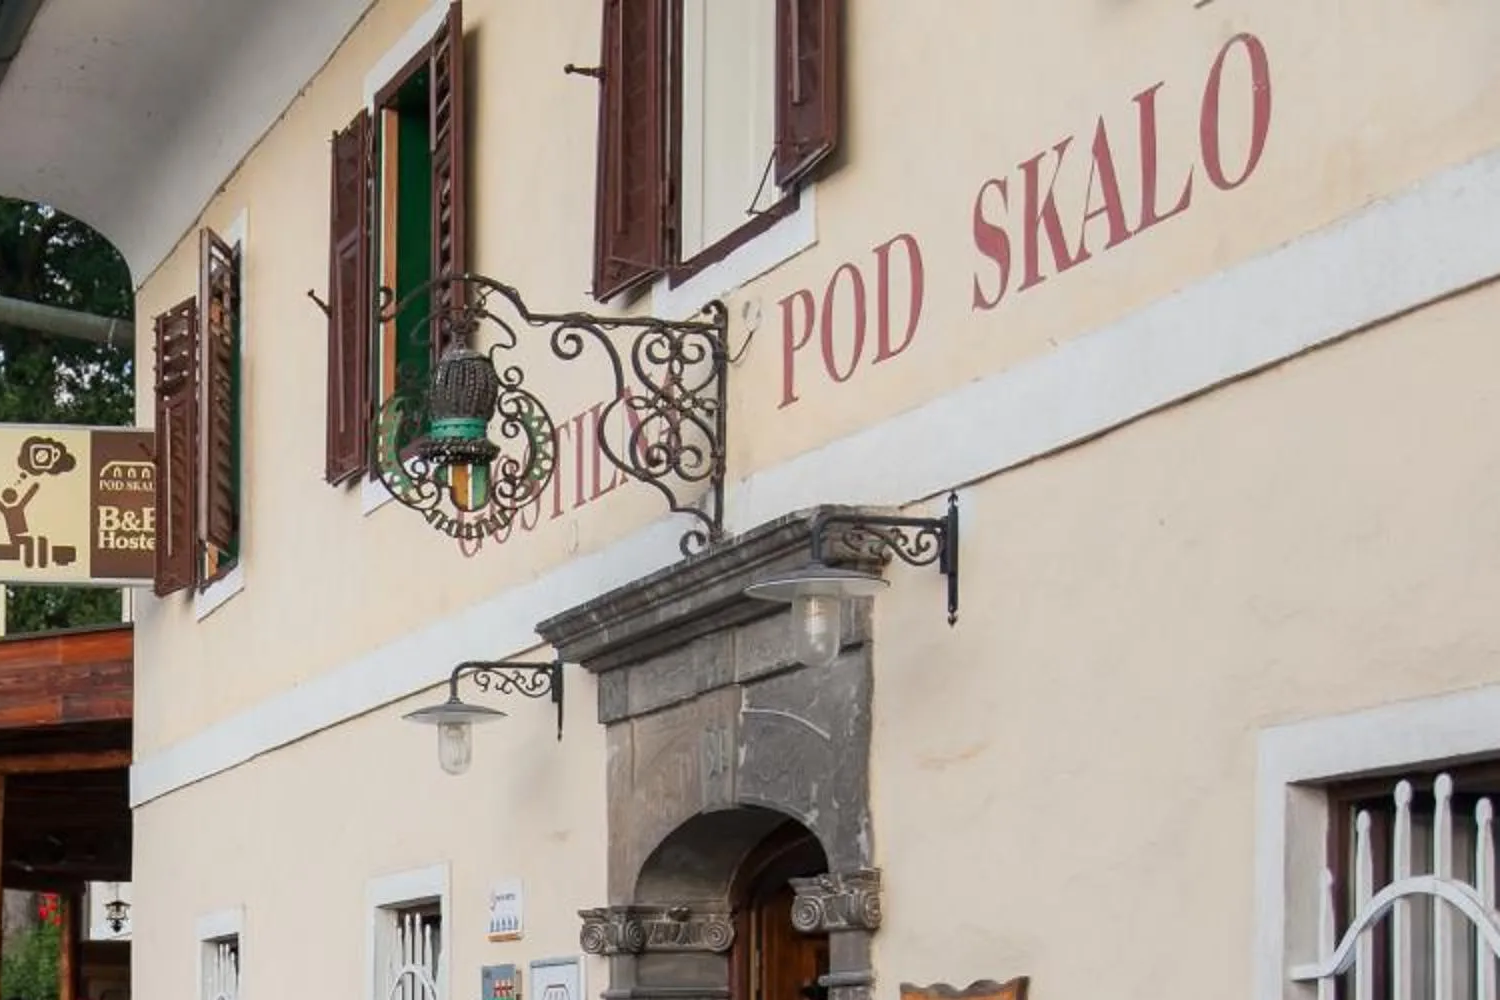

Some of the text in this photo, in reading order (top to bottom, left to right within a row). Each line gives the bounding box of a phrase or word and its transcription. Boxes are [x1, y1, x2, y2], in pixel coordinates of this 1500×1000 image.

[778, 233, 924, 410] POD
[971, 32, 1272, 311] SKALO
[100, 480, 125, 491] POD
[98, 531, 156, 550] Hoste
